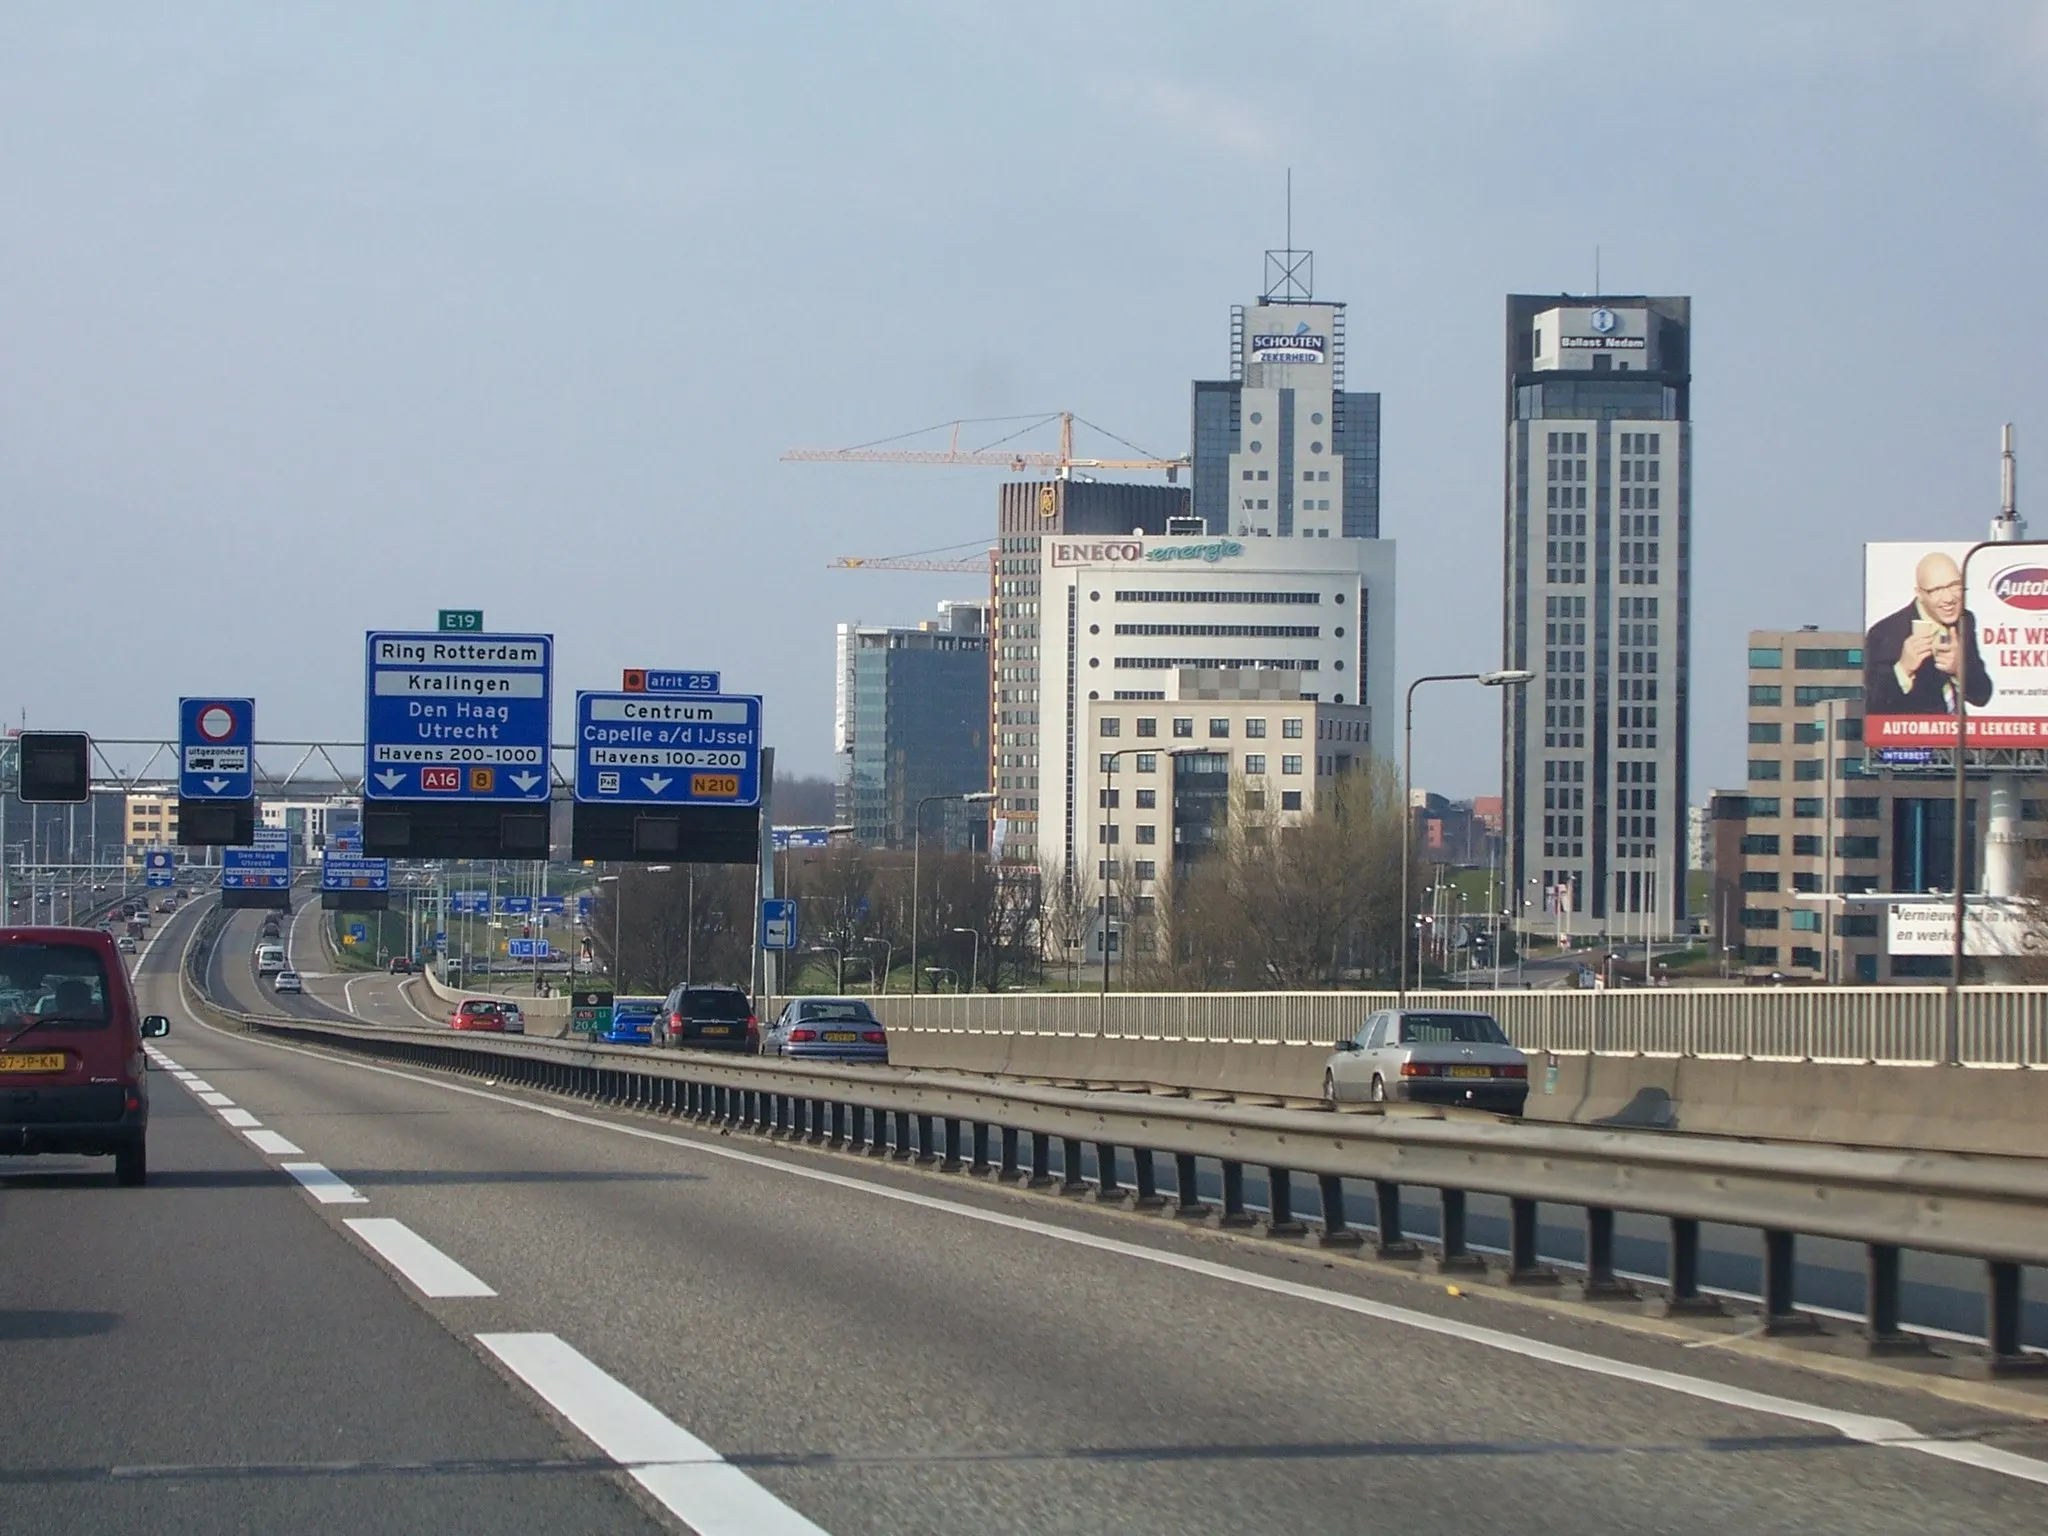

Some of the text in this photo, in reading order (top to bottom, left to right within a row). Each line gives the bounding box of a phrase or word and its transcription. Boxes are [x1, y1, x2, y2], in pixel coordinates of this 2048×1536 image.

[1254, 336, 1321, 348] SCHOUTEN
[1605, 338, 1644, 348] Nedam
[1261, 352, 1316, 361] ZEKERHEID
[1057, 538, 1243, 563] ENECO energie
[446, 614, 475, 628] E19
[1983, 622, 2018, 645] DÁT
[382, 643, 537, 663] Ring Rotterdam
[1999, 650, 2048, 668] LEKK
[409, 675, 510, 694] Kralingen
[651, 675, 711, 689] afrit 25
[409, 701, 509, 723] Den Haag
[624, 704, 713, 720] Centrum
[418, 722, 500, 739] Utrecht
[584, 725, 753, 745] Capelle a/d IJssel
[1882, 721, 1976, 736] AUTOMATISH
[1980, 722, 2036, 736] LEKKERE
[188, 748, 245, 756] uitgezonderd
[379, 747, 537, 762] Havens 200-1000
[595, 751, 741, 766] Havens 100-200
[425, 772, 487, 787] A16 8
[1896, 932, 1912, 941] en
